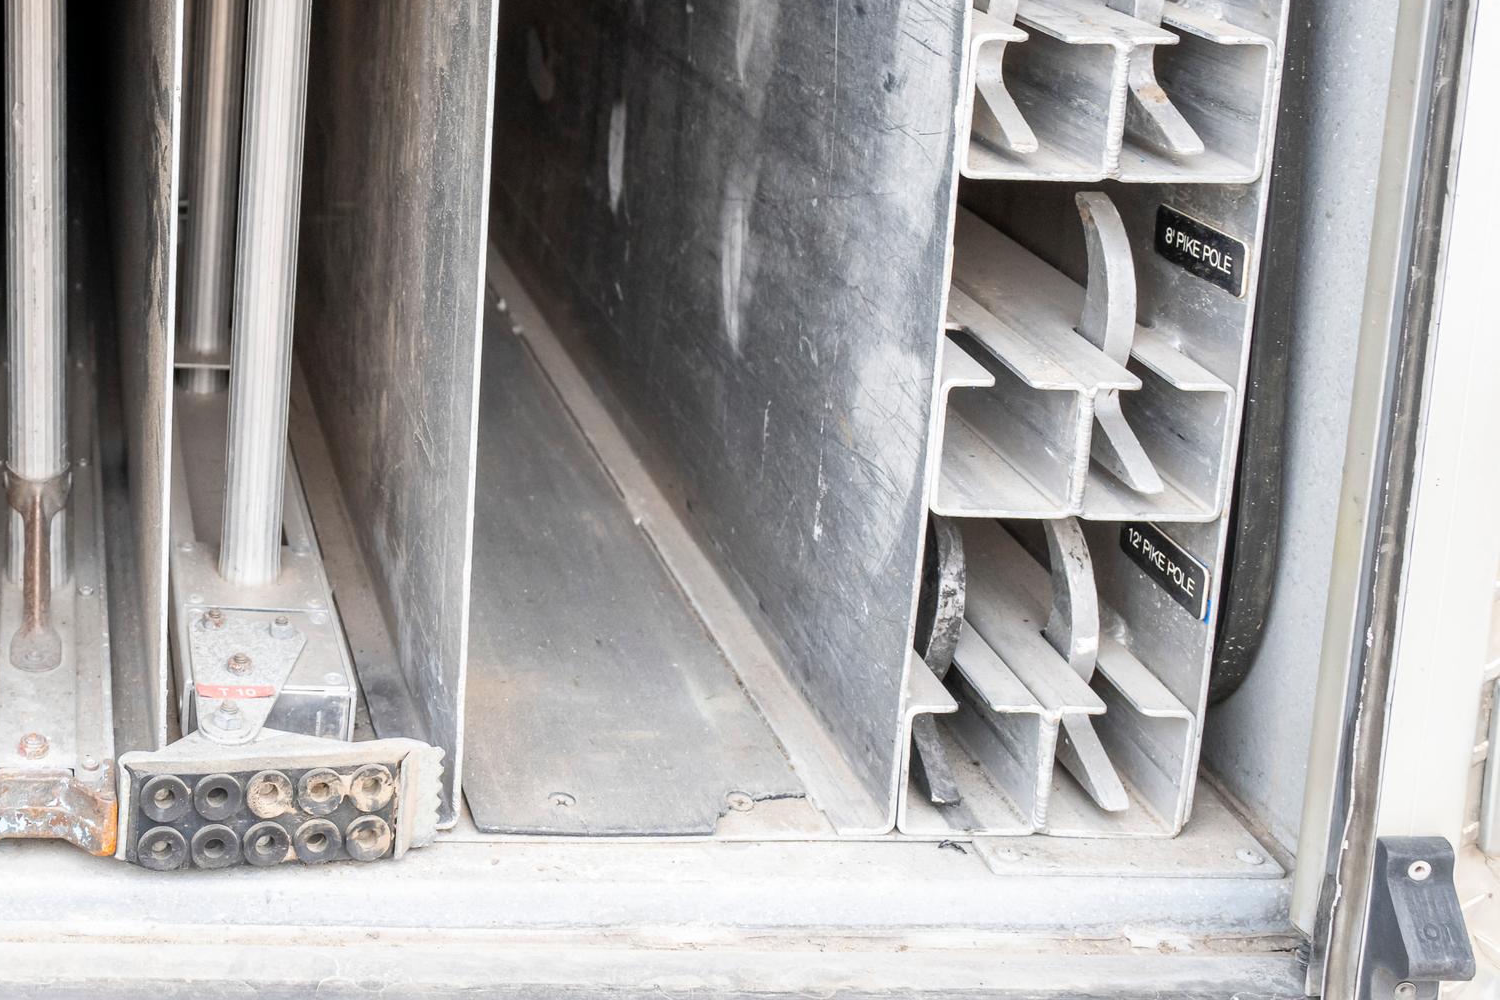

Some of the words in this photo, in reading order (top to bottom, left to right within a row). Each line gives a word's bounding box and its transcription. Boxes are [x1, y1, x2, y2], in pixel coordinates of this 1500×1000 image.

[1165, 226, 1175, 245] 8'
[1176, 230, 1201, 258] PIKE
[1202, 243, 1232, 275] POLE
[1128, 527, 1142, 548] 12'
[1142, 539, 1166, 571] PIKE
[1166, 557, 1196, 597] POLE
